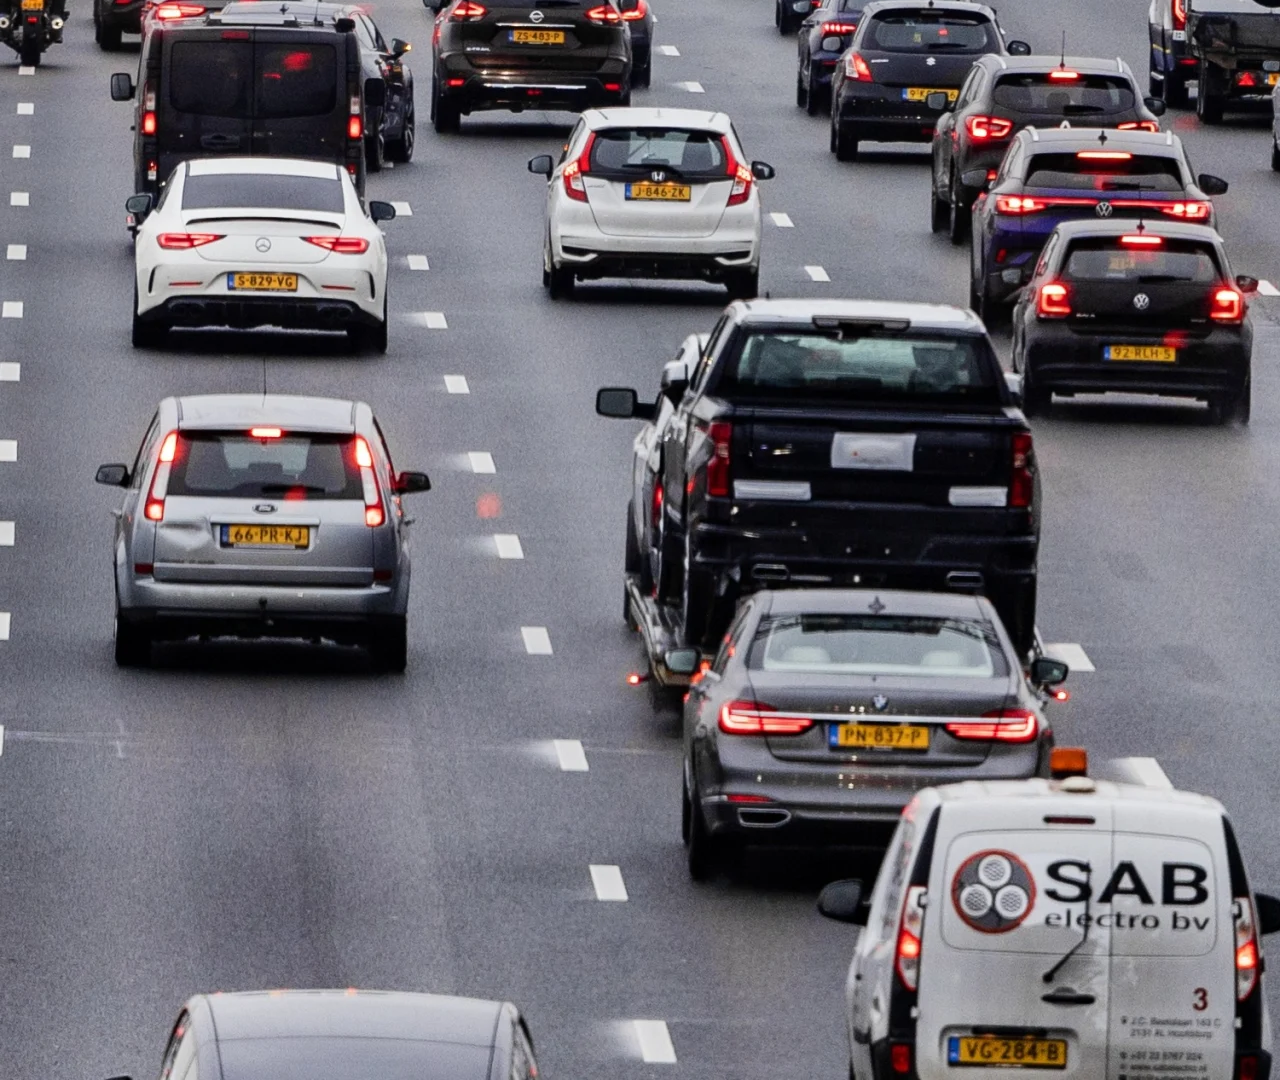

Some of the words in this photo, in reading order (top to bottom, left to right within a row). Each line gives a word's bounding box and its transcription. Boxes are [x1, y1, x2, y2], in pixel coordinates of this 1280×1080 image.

[516, 31, 560, 40] ZS-483-P
[635, 186, 685, 197] J-846-ZK
[237, 276, 294, 287] S-829-VG
[1113, 348, 1172, 360] 92-RLH-5
[234, 528, 302, 543] 66-PR-KJ
[844, 729, 921, 745] PN-837-P
[1045, 859, 1210, 907] SAB
[1044, 910, 1160, 932] electro
[1170, 908, 1210, 932] bv
[1192, 986, 1209, 1012] 3
[967, 1039, 1059, 1061] VG-284-B
